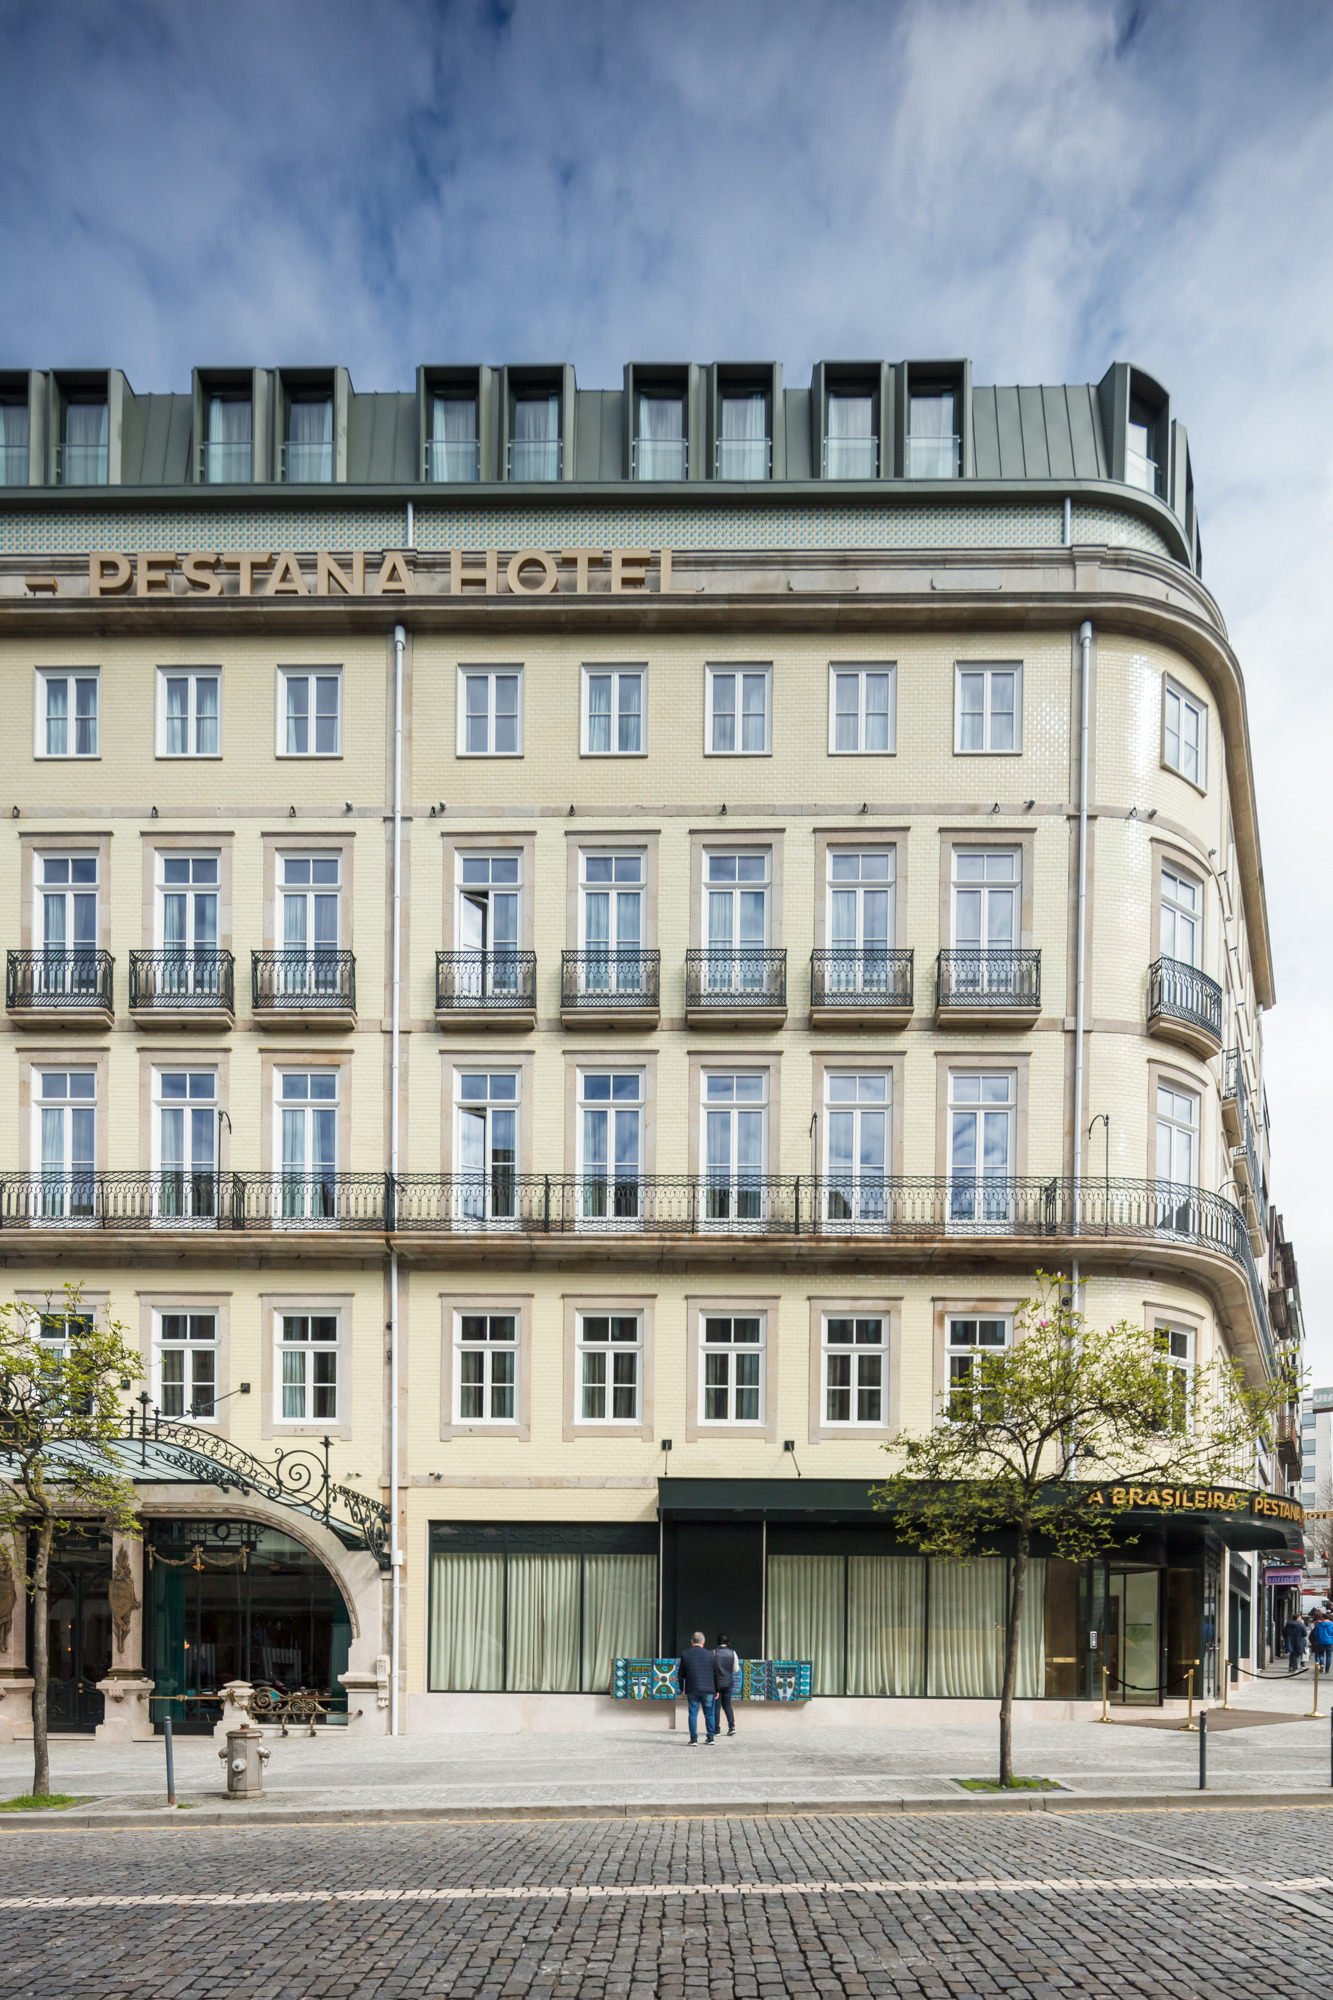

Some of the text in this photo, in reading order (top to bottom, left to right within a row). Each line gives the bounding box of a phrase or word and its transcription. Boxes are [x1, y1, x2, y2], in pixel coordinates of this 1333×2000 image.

[89, 550, 418, 596] PESTANA
[450, 549, 697, 595] HOTEL
[1088, 1490, 1104, 1504] A
[1112, 1487, 1237, 1509] BRASILEIRA
[1253, 1497, 1302, 1521] PESTANA
